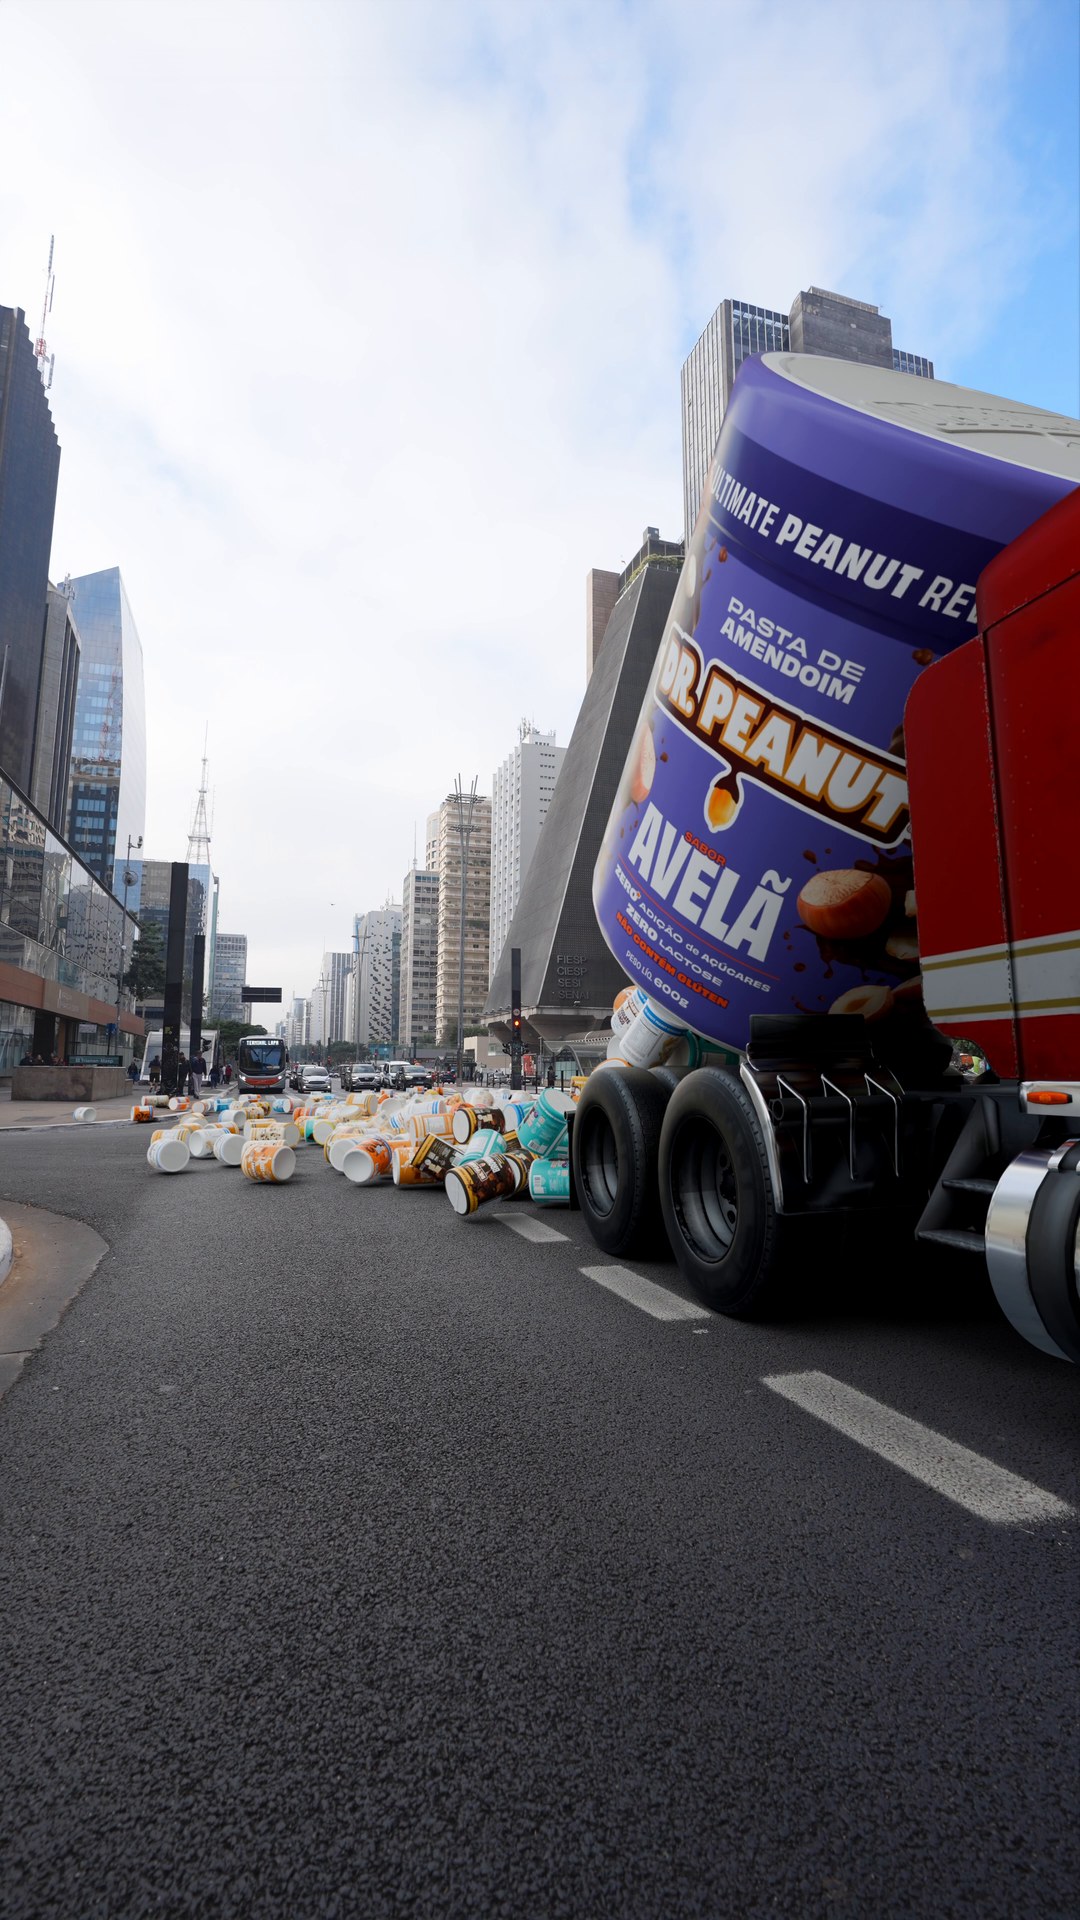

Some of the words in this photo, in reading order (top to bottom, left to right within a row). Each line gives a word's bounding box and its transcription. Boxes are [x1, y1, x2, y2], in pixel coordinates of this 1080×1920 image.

[711, 465, 780, 537] ULTIMATE
[775, 513, 924, 599] PEANUT
[719, 616, 857, 705] AMENDOIM
[727, 596, 808, 659] PASTA
[817, 649, 866, 683] DE
[659, 635, 696, 718] DR.
[697, 671, 909, 832] PEANUT
[628, 801, 792, 963] AVELÃ
[684, 831, 727, 868] SABOR
[556, 954, 587, 964] FIESP
[556, 966, 587, 976] CIESP
[558, 978, 581, 988] SESI
[616, 911, 633, 936] NÃO
[633, 933, 677, 976] CONTÉM
[677, 972, 729, 1009] GLÚTEN
[625, 950, 642, 970] PESO
[653, 977, 689, 1008] 600g
[626, 902, 658, 941] ZERO
[659, 939, 723, 987] LACTOSE
[639, 902, 683, 943] ADIÇÃO
[685, 943, 700, 956] de
[701, 953, 771, 992] AÇÚCARES
[559, 990, 589, 1000] SENAI
